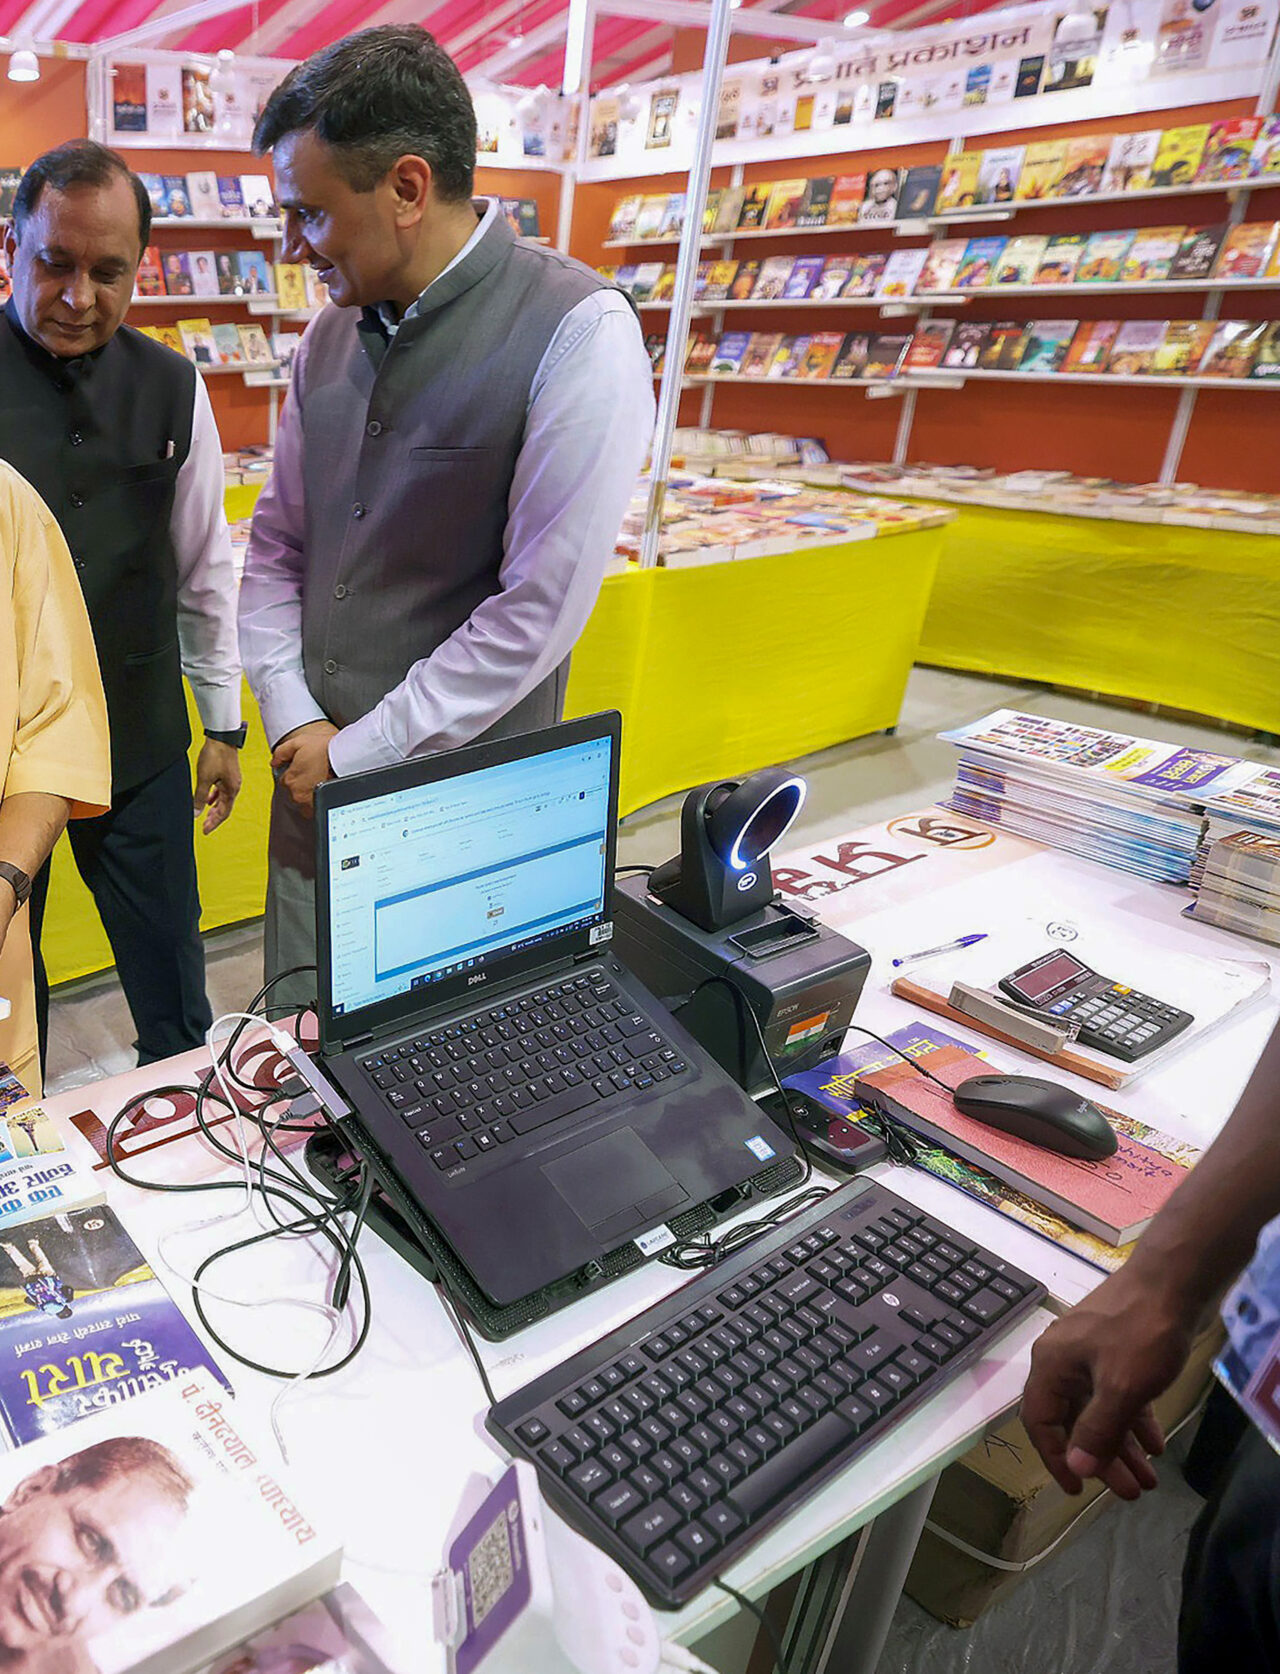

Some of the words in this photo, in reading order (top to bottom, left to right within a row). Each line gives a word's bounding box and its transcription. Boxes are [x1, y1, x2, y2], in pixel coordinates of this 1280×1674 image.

[467, 973, 487, 986] DELL
[776, 1002, 799, 1018] EPSON
[26, 1184, 65, 1207] एक
[194, 1400, 258, 1470] दीनदयाल
[257, 1474, 317, 1546] पाध्याय
